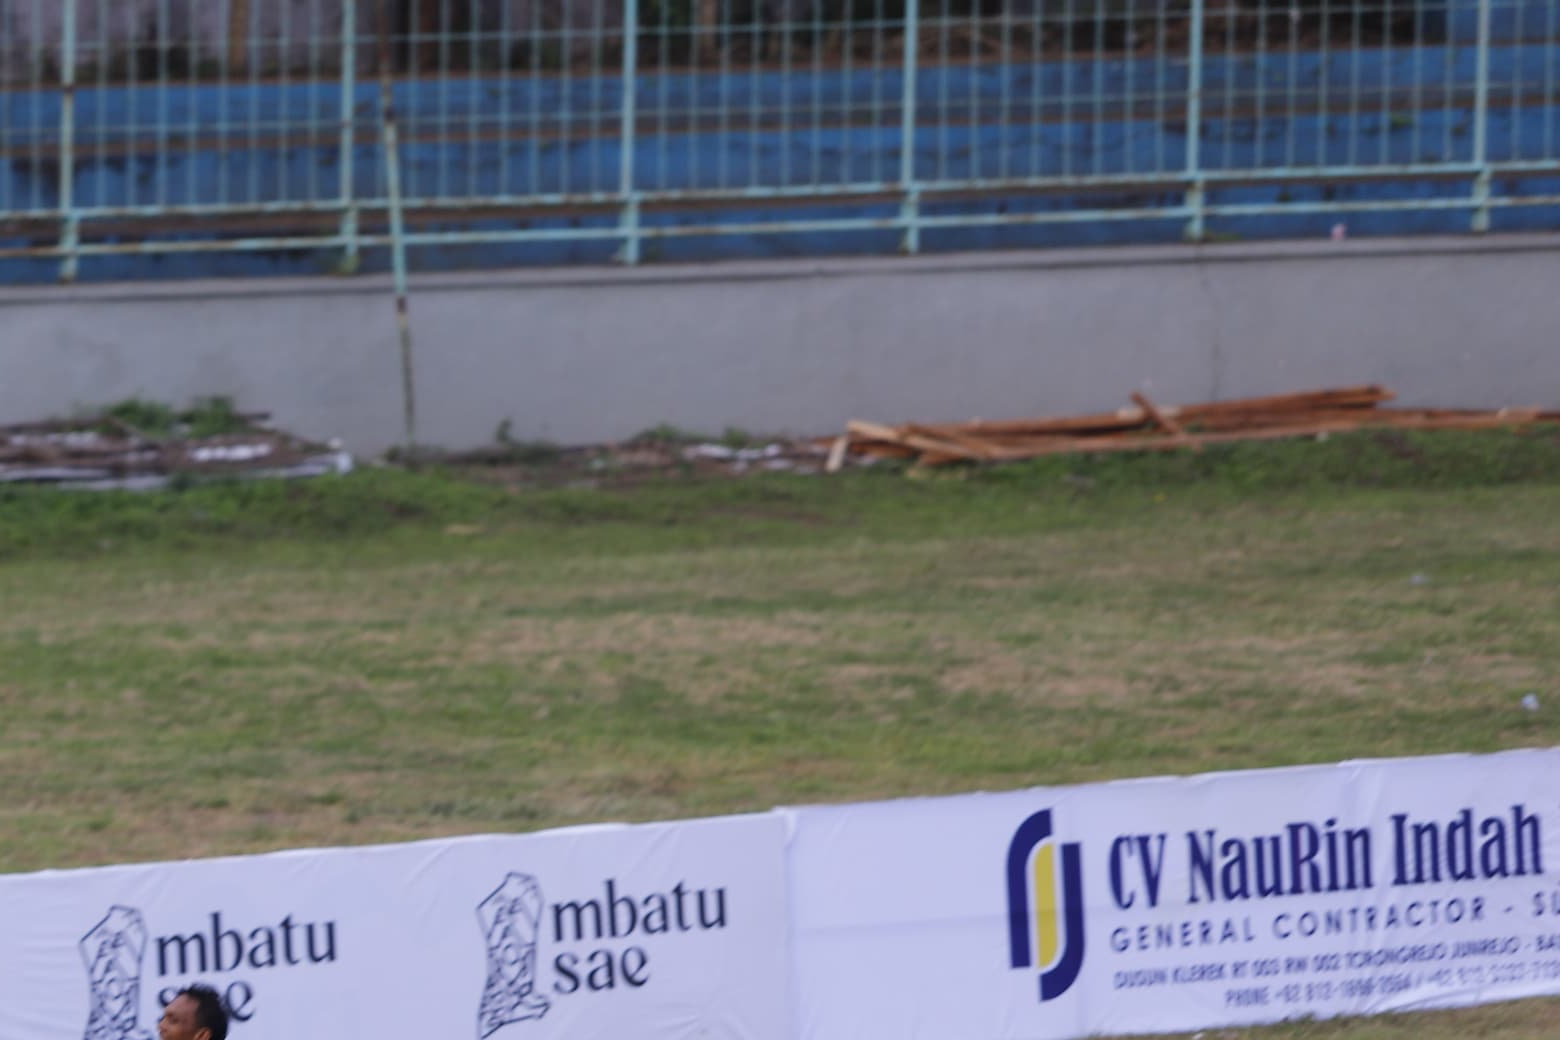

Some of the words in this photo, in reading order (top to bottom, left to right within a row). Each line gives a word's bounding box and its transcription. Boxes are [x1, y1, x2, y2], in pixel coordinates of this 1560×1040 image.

[1109, 833, 1168, 911] CV
[1186, 817, 1374, 904] NauRin
[1391, 803, 1545, 886] Indah
[551, 878, 727, 943] mbatu
[1109, 915, 1256, 953] GENERAL
[1271, 895, 1485, 941] CONTRACTOR
[155, 910, 337, 977] mbatu
[553, 946, 650, 995] sae
